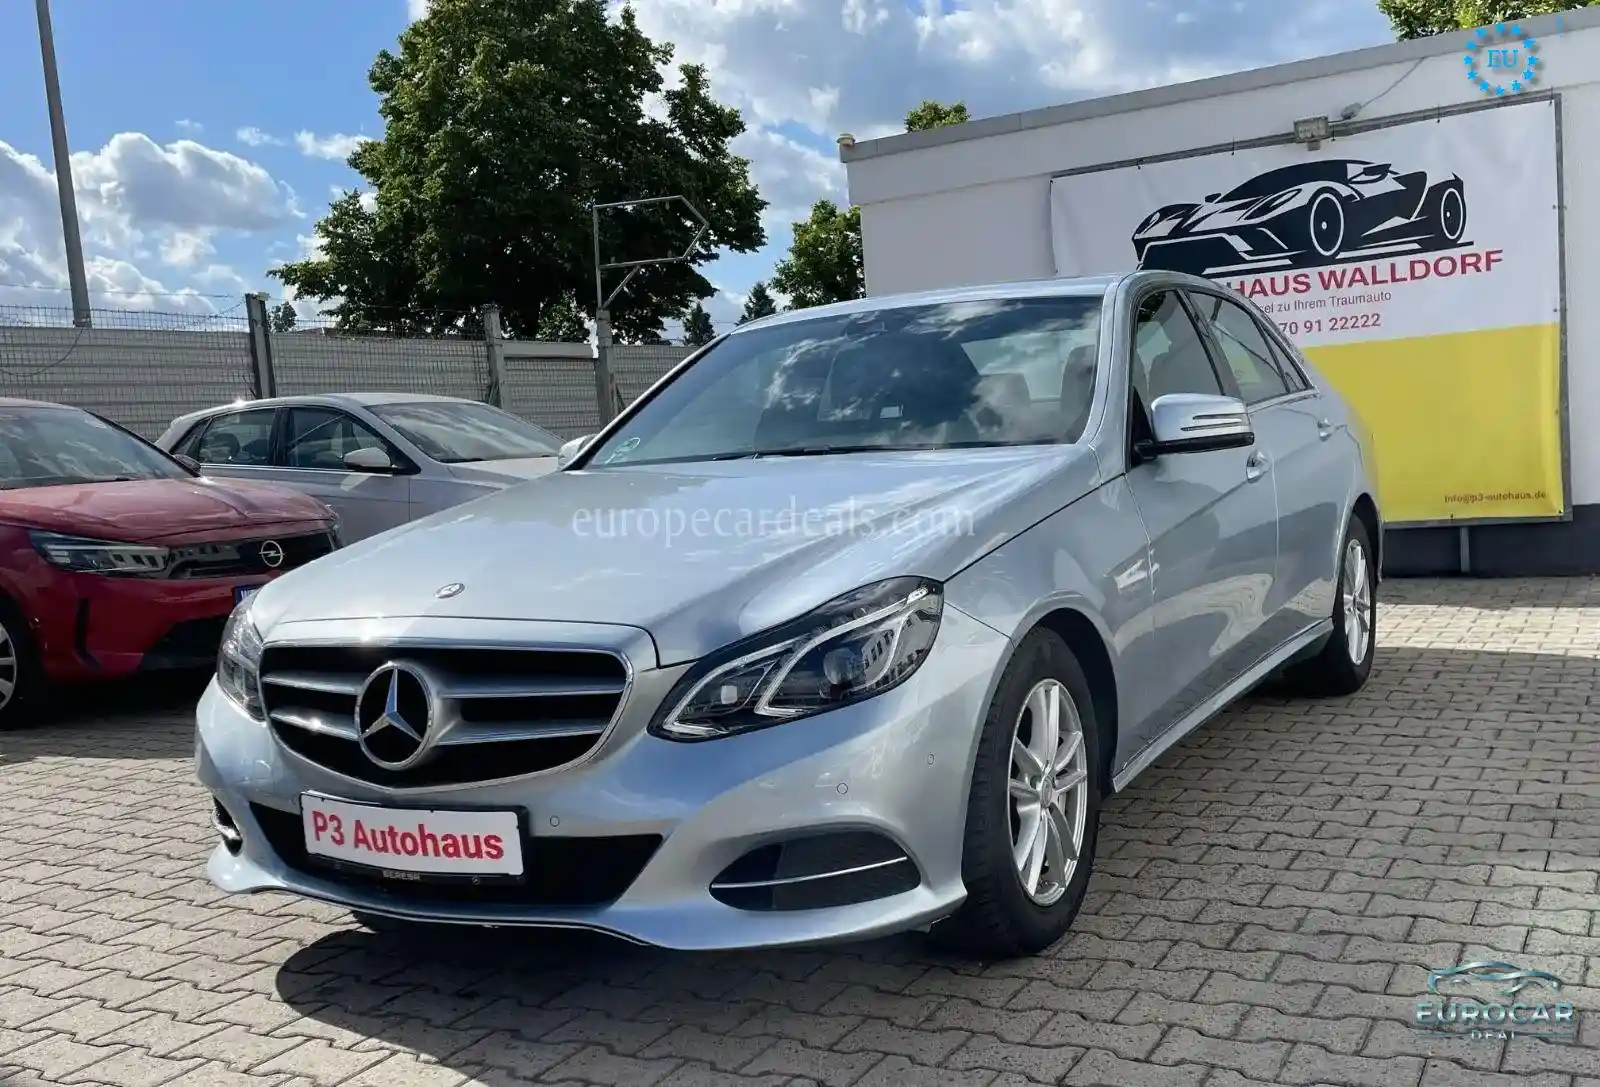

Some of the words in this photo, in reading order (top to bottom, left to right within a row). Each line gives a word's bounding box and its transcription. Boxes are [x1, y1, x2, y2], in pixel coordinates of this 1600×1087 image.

[1317, 249, 1504, 291] WALLDORF
[1277, 303, 1291, 312] zu
[1294, 299, 1326, 310] Ihrem
[1329, 291, 1392, 307] Traumauto
[1303, 320, 1322, 333] 91
[1328, 313, 1381, 331] 22222
[312, 810, 345, 846] P3
[354, 819, 504, 860] Autohaus
